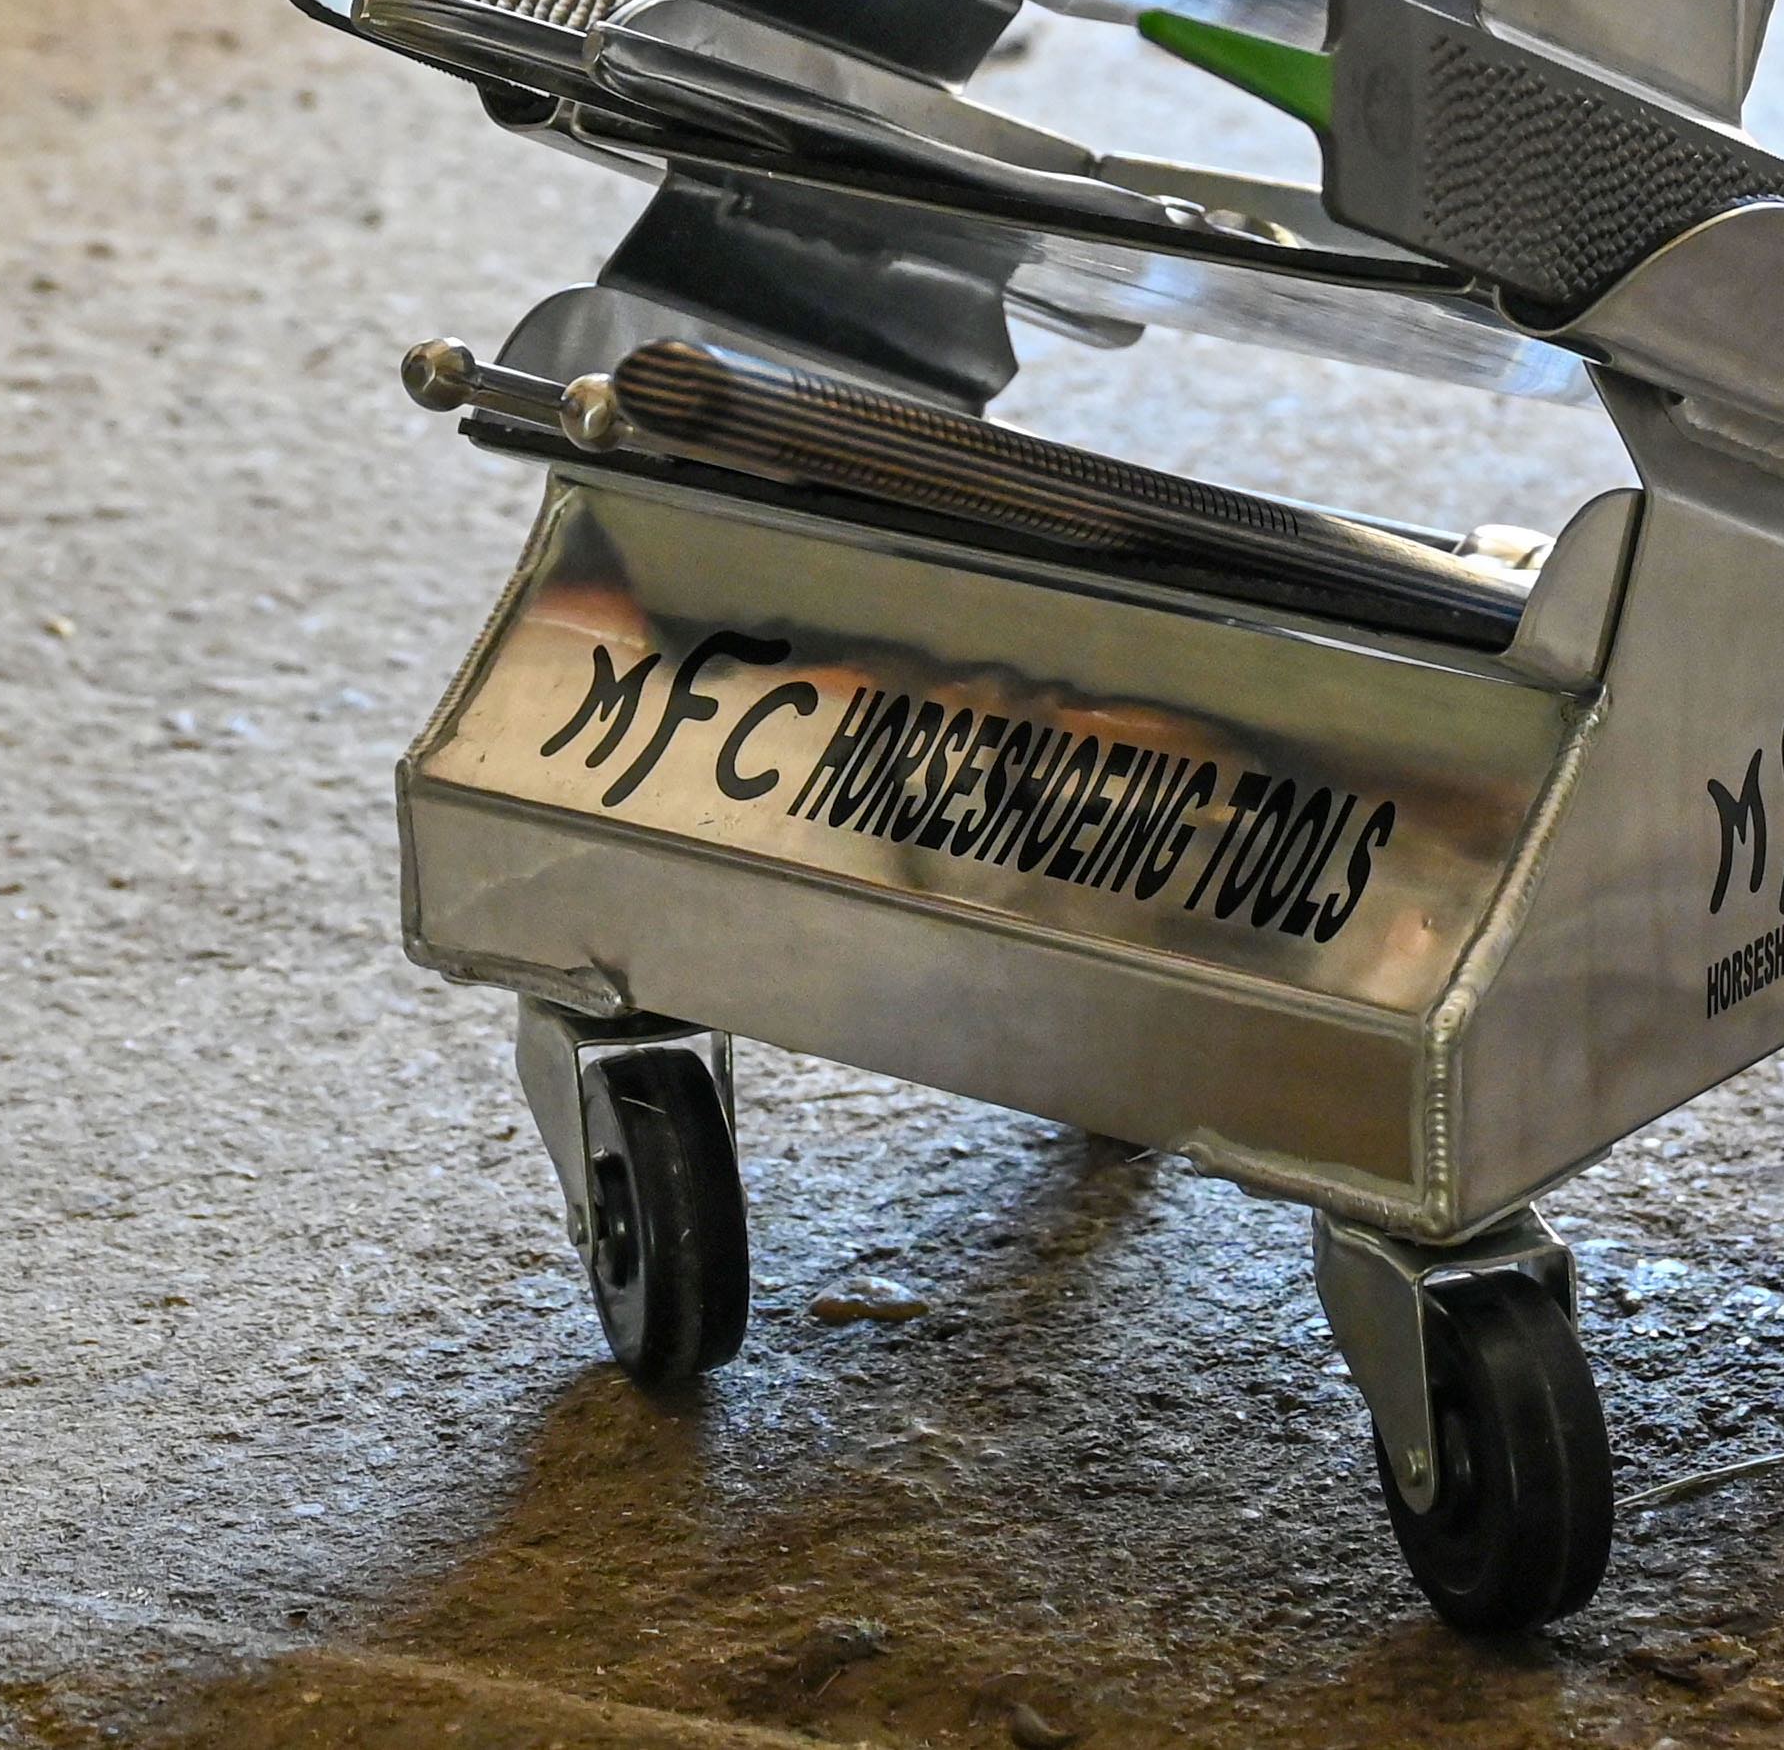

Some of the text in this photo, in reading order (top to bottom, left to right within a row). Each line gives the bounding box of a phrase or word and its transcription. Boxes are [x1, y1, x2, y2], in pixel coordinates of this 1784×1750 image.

[540, 630, 1397, 945] MFC HORSESHOEING TOOLS
